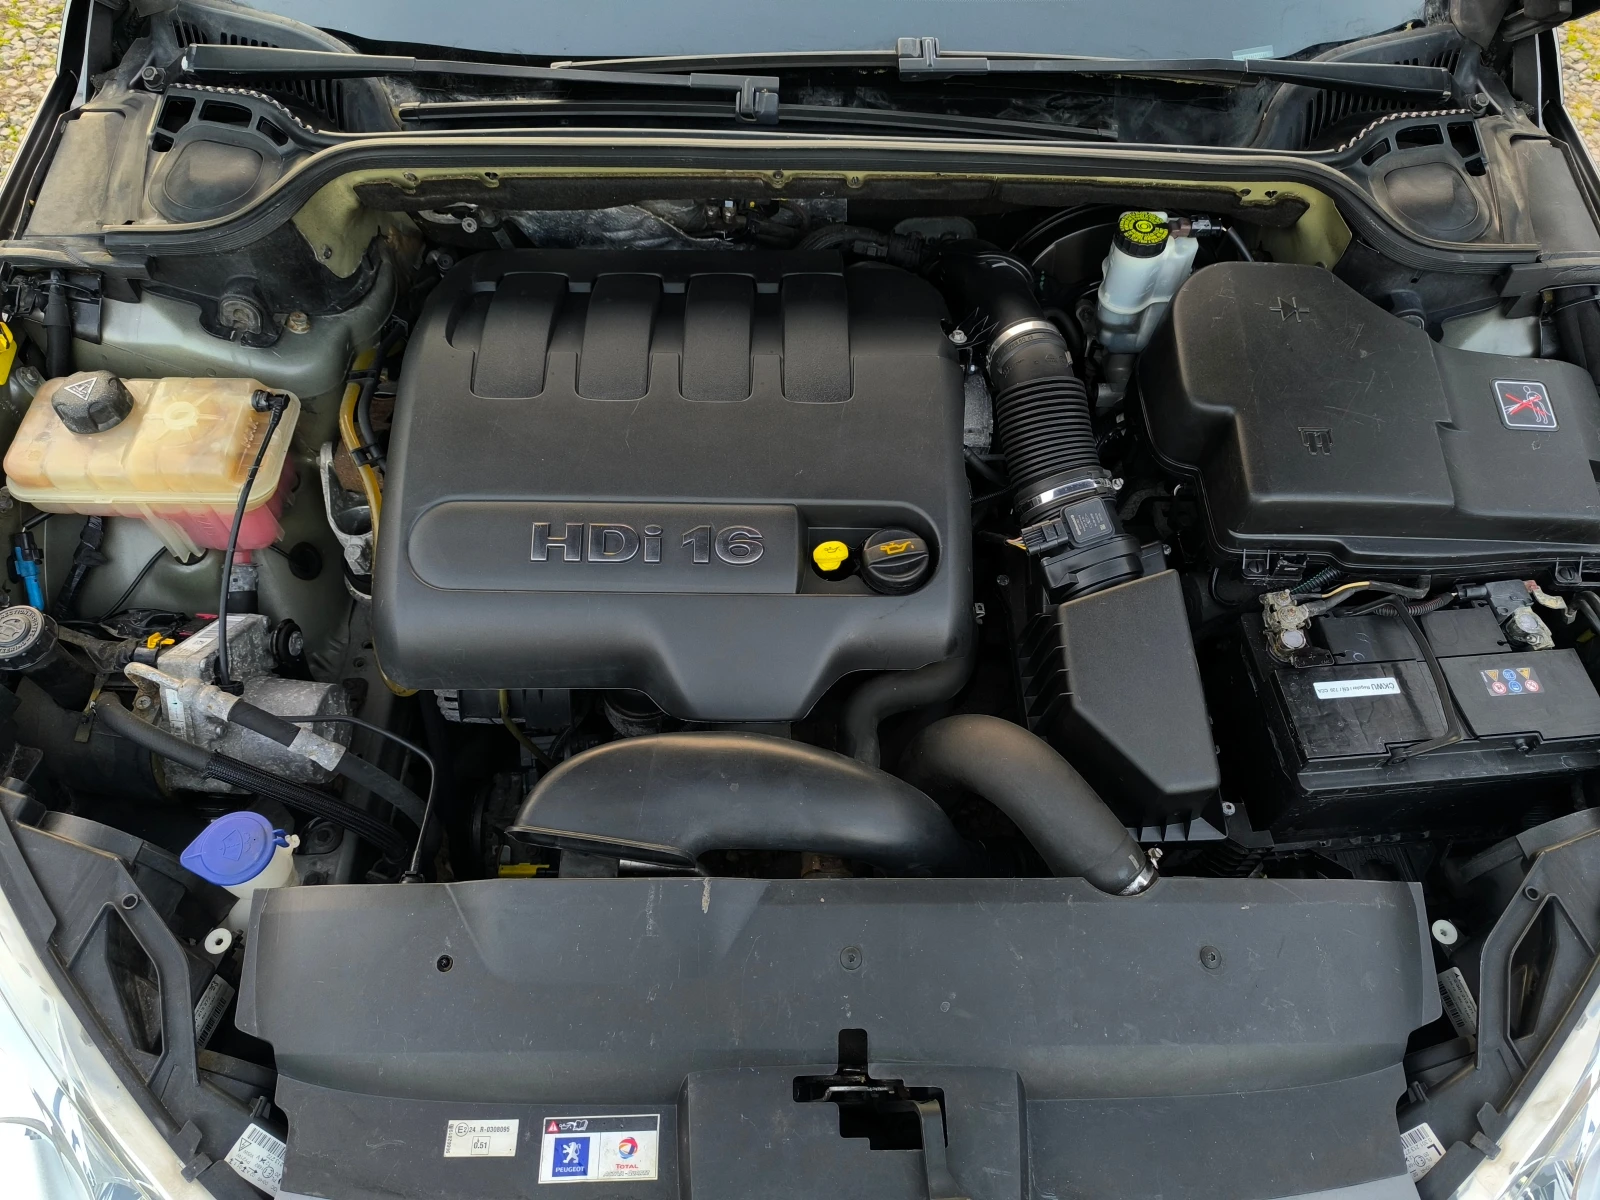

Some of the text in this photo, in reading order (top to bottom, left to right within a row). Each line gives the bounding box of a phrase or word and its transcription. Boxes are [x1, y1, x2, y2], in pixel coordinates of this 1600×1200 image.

[530, 522, 764, 565] HDi 16
[1427, 1144, 1442, 1156] L
[266, 1153, 274, 1162] 272
